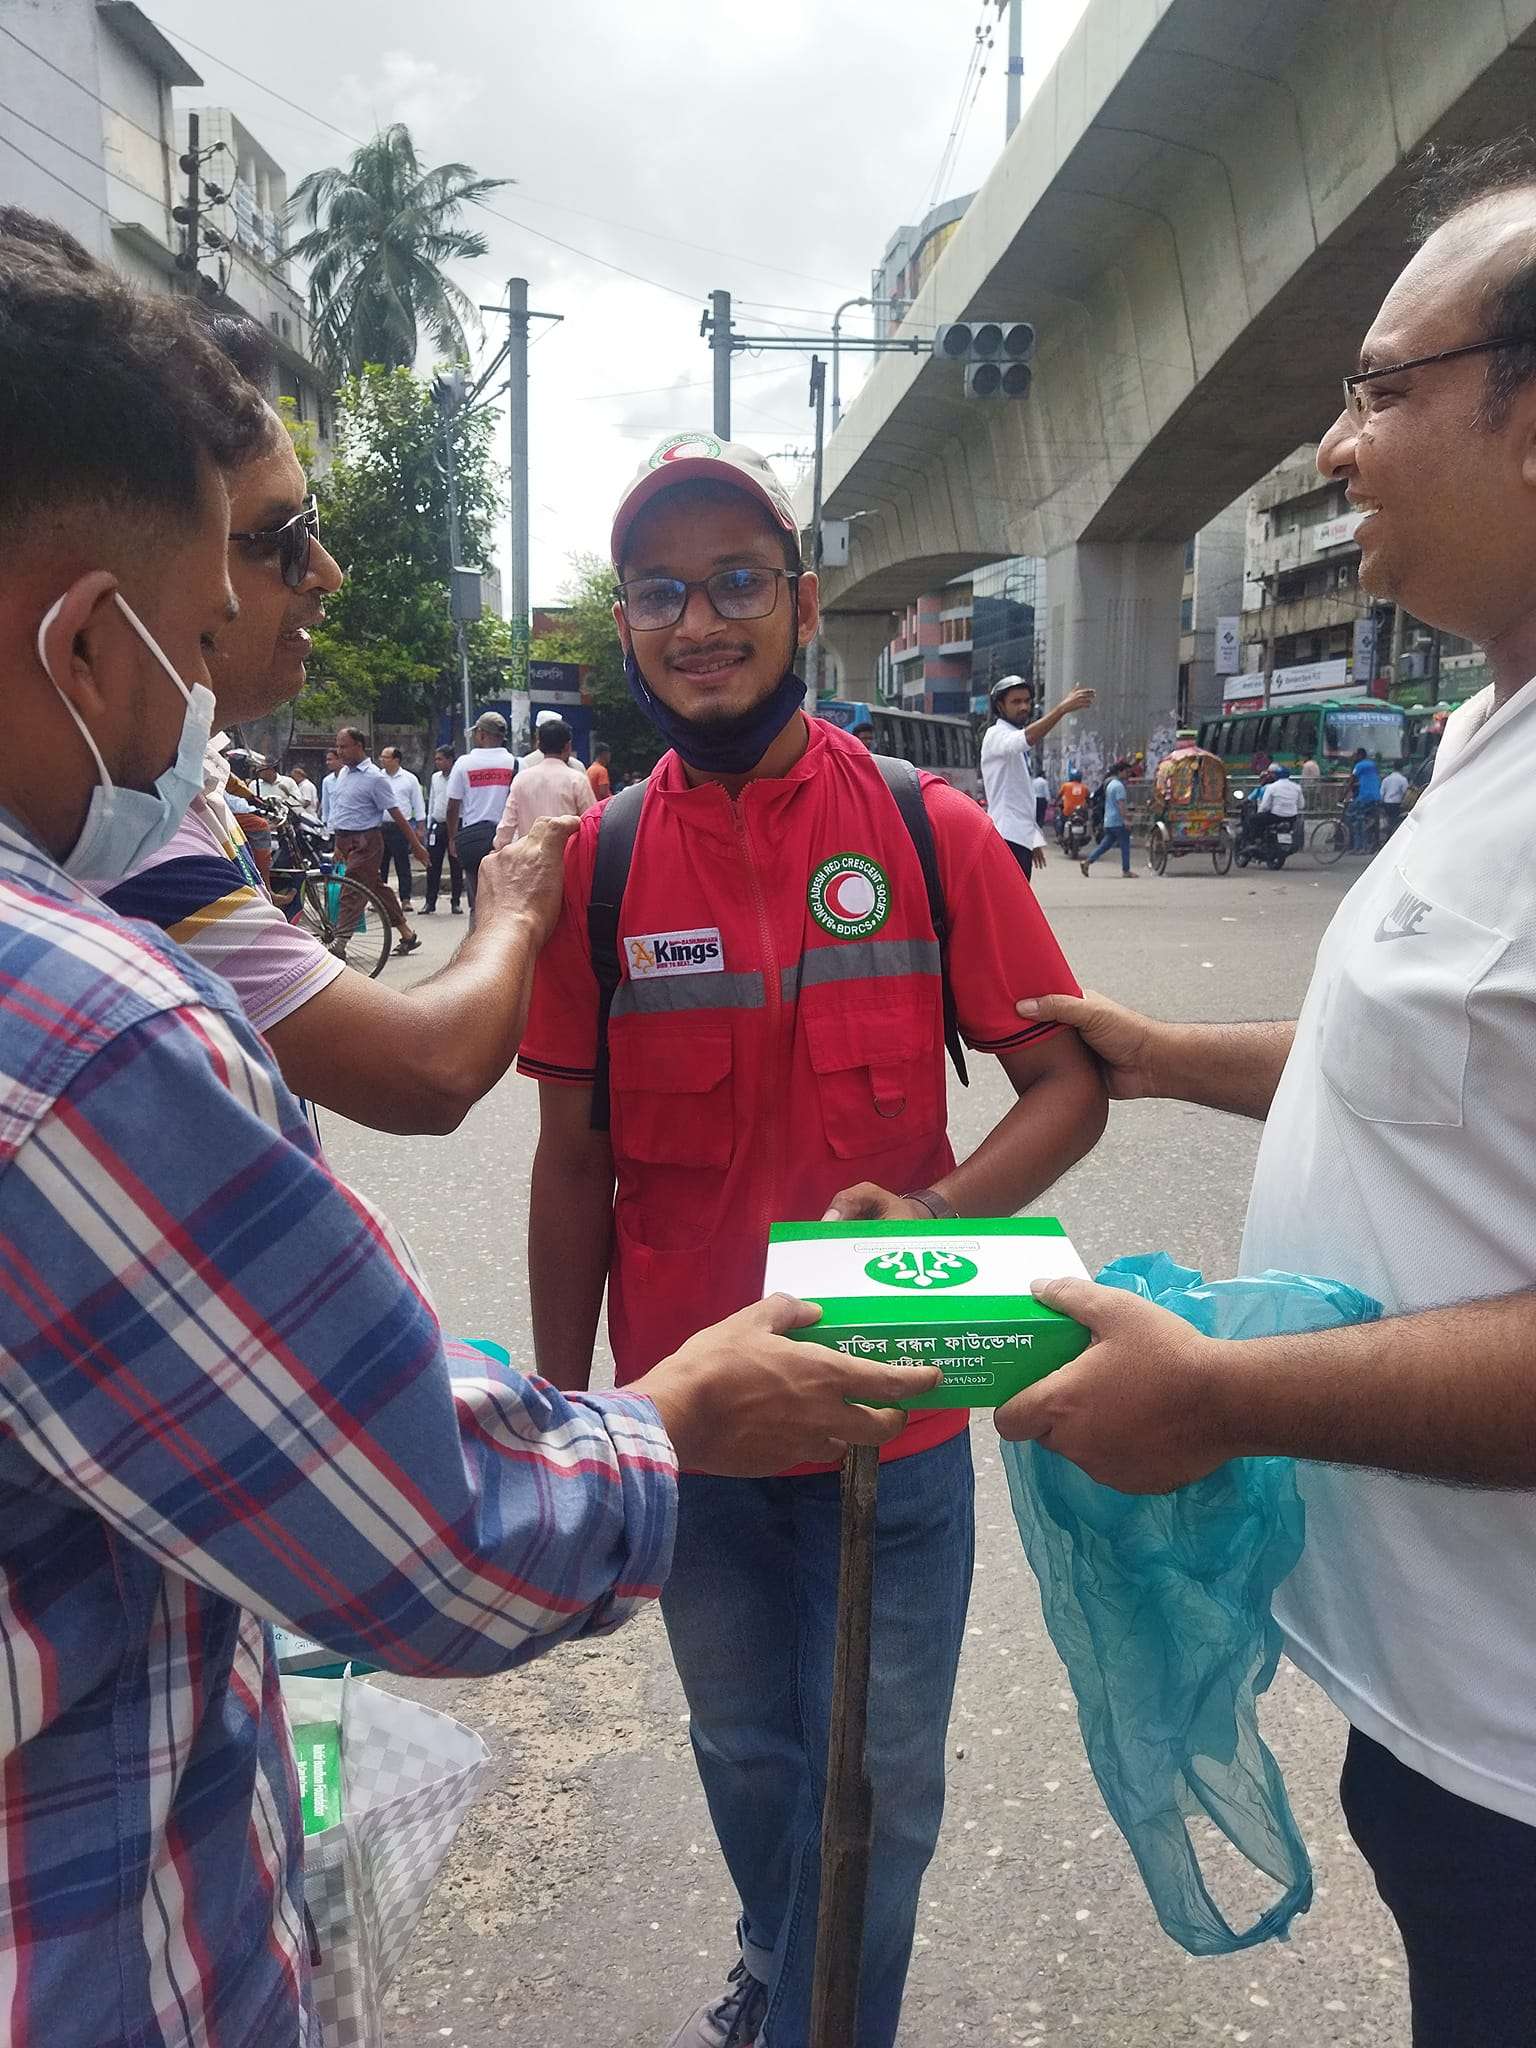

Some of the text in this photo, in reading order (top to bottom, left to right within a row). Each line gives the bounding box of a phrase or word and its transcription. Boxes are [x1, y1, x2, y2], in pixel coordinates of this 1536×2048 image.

[811, 858, 887, 928] BANGLADESH RED CRESCENT SOCIETY
[837, 921, 873, 935] BDRCS
[654, 940, 718, 964] Kings
[837, 1332, 1034, 1356] মক্তির বন্ধন ফাউন্ডেশন
[943, 1375, 987, 1385] ২৮৭৭/২০১৮
[314, 1784, 328, 1816] Foundation
